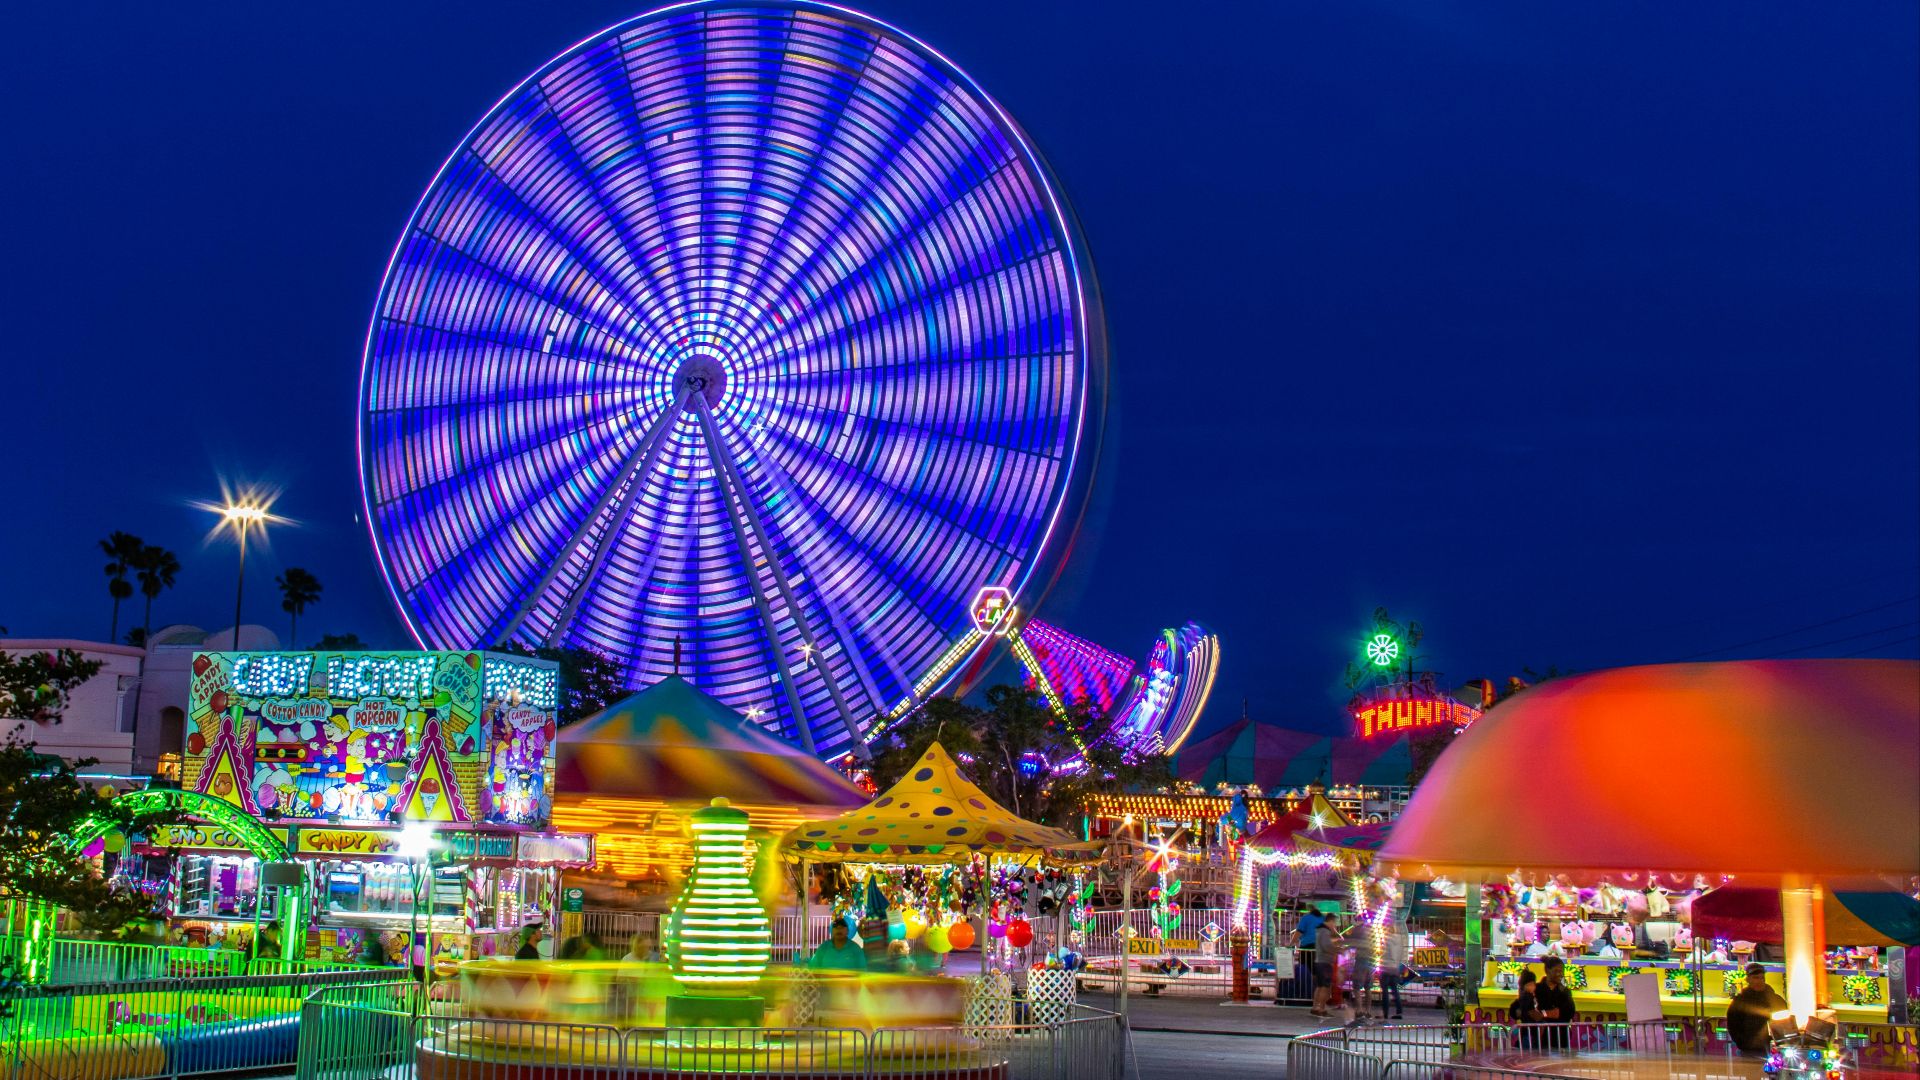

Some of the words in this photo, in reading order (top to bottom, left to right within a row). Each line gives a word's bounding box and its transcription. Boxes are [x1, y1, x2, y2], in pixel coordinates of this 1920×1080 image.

[194, 662, 222, 693] CANDY
[233, 655, 315, 697] CANDY
[327, 655, 438, 699] FACTORY
[450, 664, 472, 686] SNO
[200, 673, 230, 704] APPLES
[438, 674, 470, 703] CONES
[267, 703, 297, 720] COTTON
[299, 704, 326, 717] CANDY
[365, 701, 385, 711] HOT
[354, 710, 399, 726] POPCORN
[511, 710, 531, 721] CANDY
[520, 717, 543, 728] APPLES
[168, 827, 207, 845] SNO
[306, 831, 366, 851] CANDY
[1129, 940, 1158, 954] EXIT
[1416, 949, 1447, 964] ENTER
